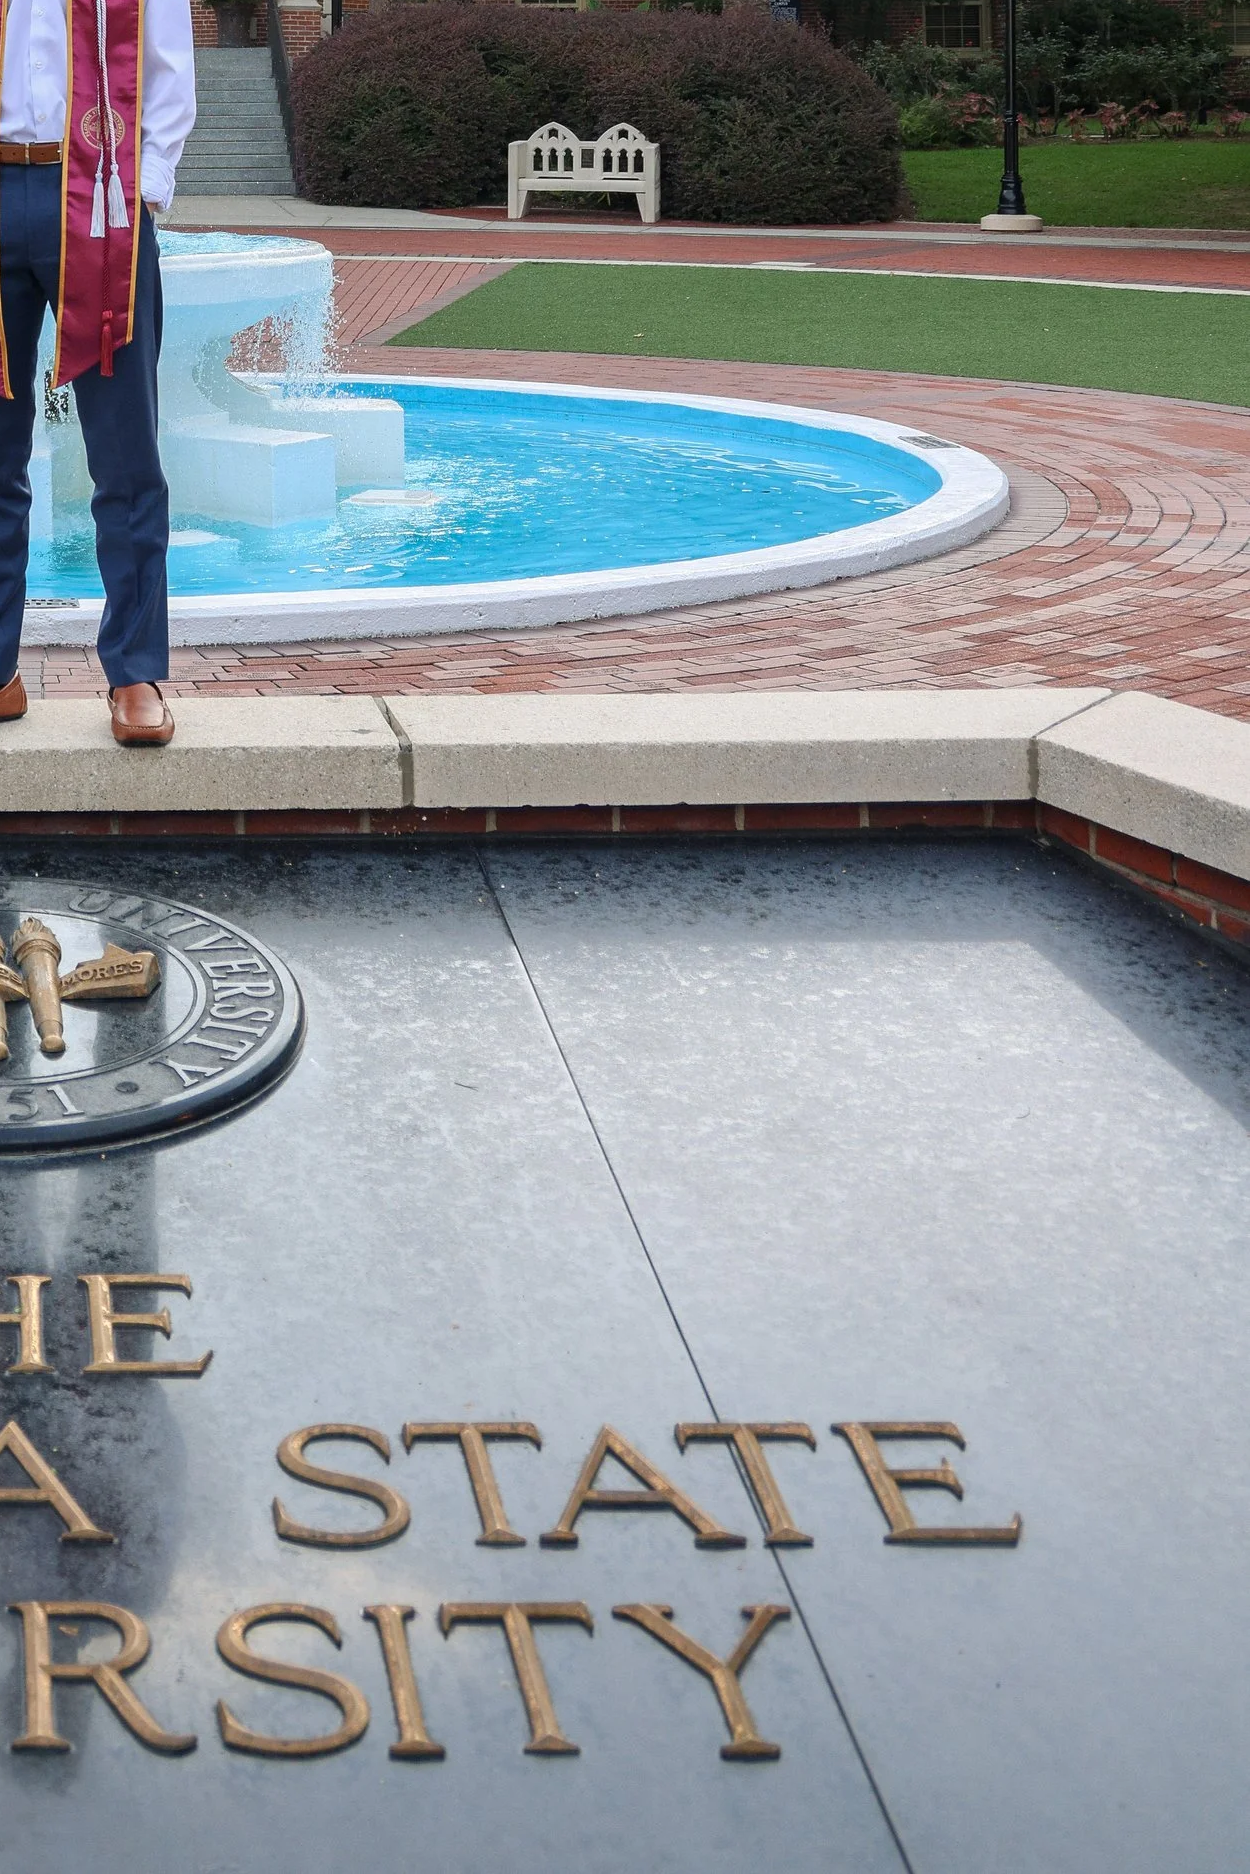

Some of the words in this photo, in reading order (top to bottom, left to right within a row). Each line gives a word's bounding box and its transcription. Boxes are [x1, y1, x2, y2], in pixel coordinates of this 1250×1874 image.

[60, 959, 144, 987] MORES
[68, 887, 276, 1088] UNIVERSITY
[271, 1420, 1022, 1550] STATE
